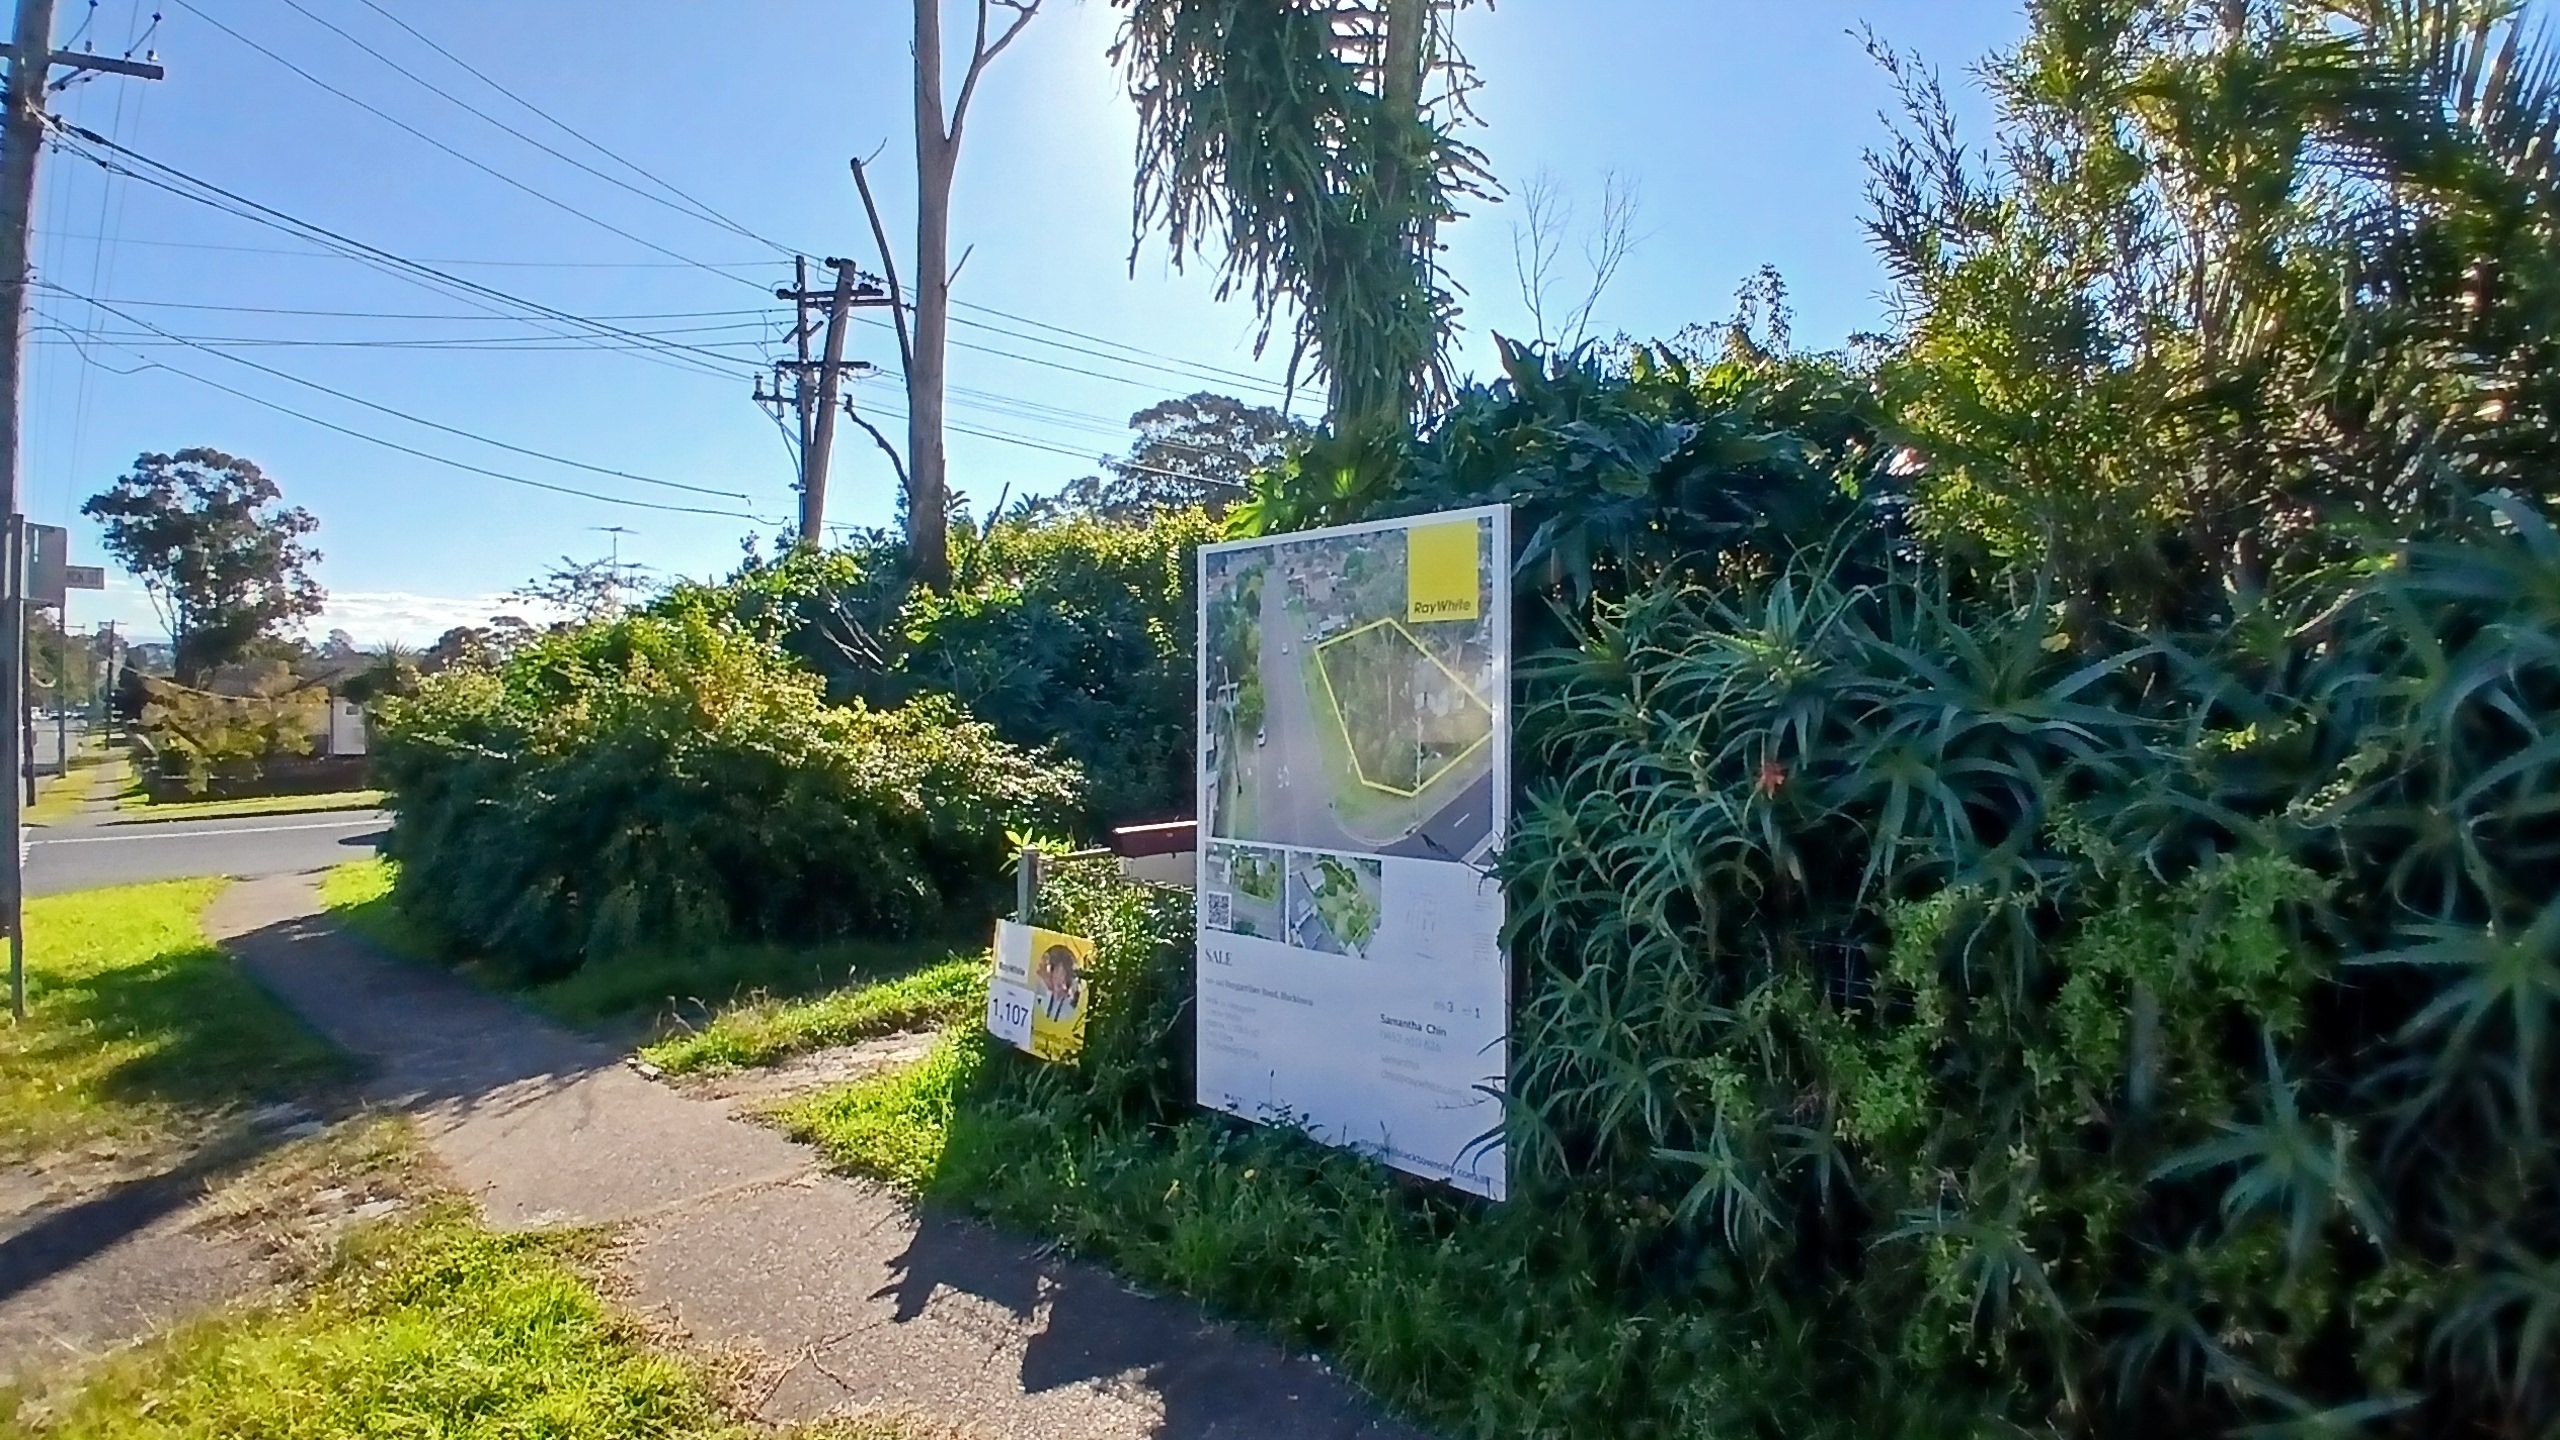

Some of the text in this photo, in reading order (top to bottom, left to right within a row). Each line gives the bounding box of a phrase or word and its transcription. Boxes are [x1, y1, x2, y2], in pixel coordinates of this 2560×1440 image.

[1205, 947, 1233, 967] SALE
[1447, 1001, 1481, 1019] 3 1
[1380, 1013, 1447, 1037] Samantha Chin
